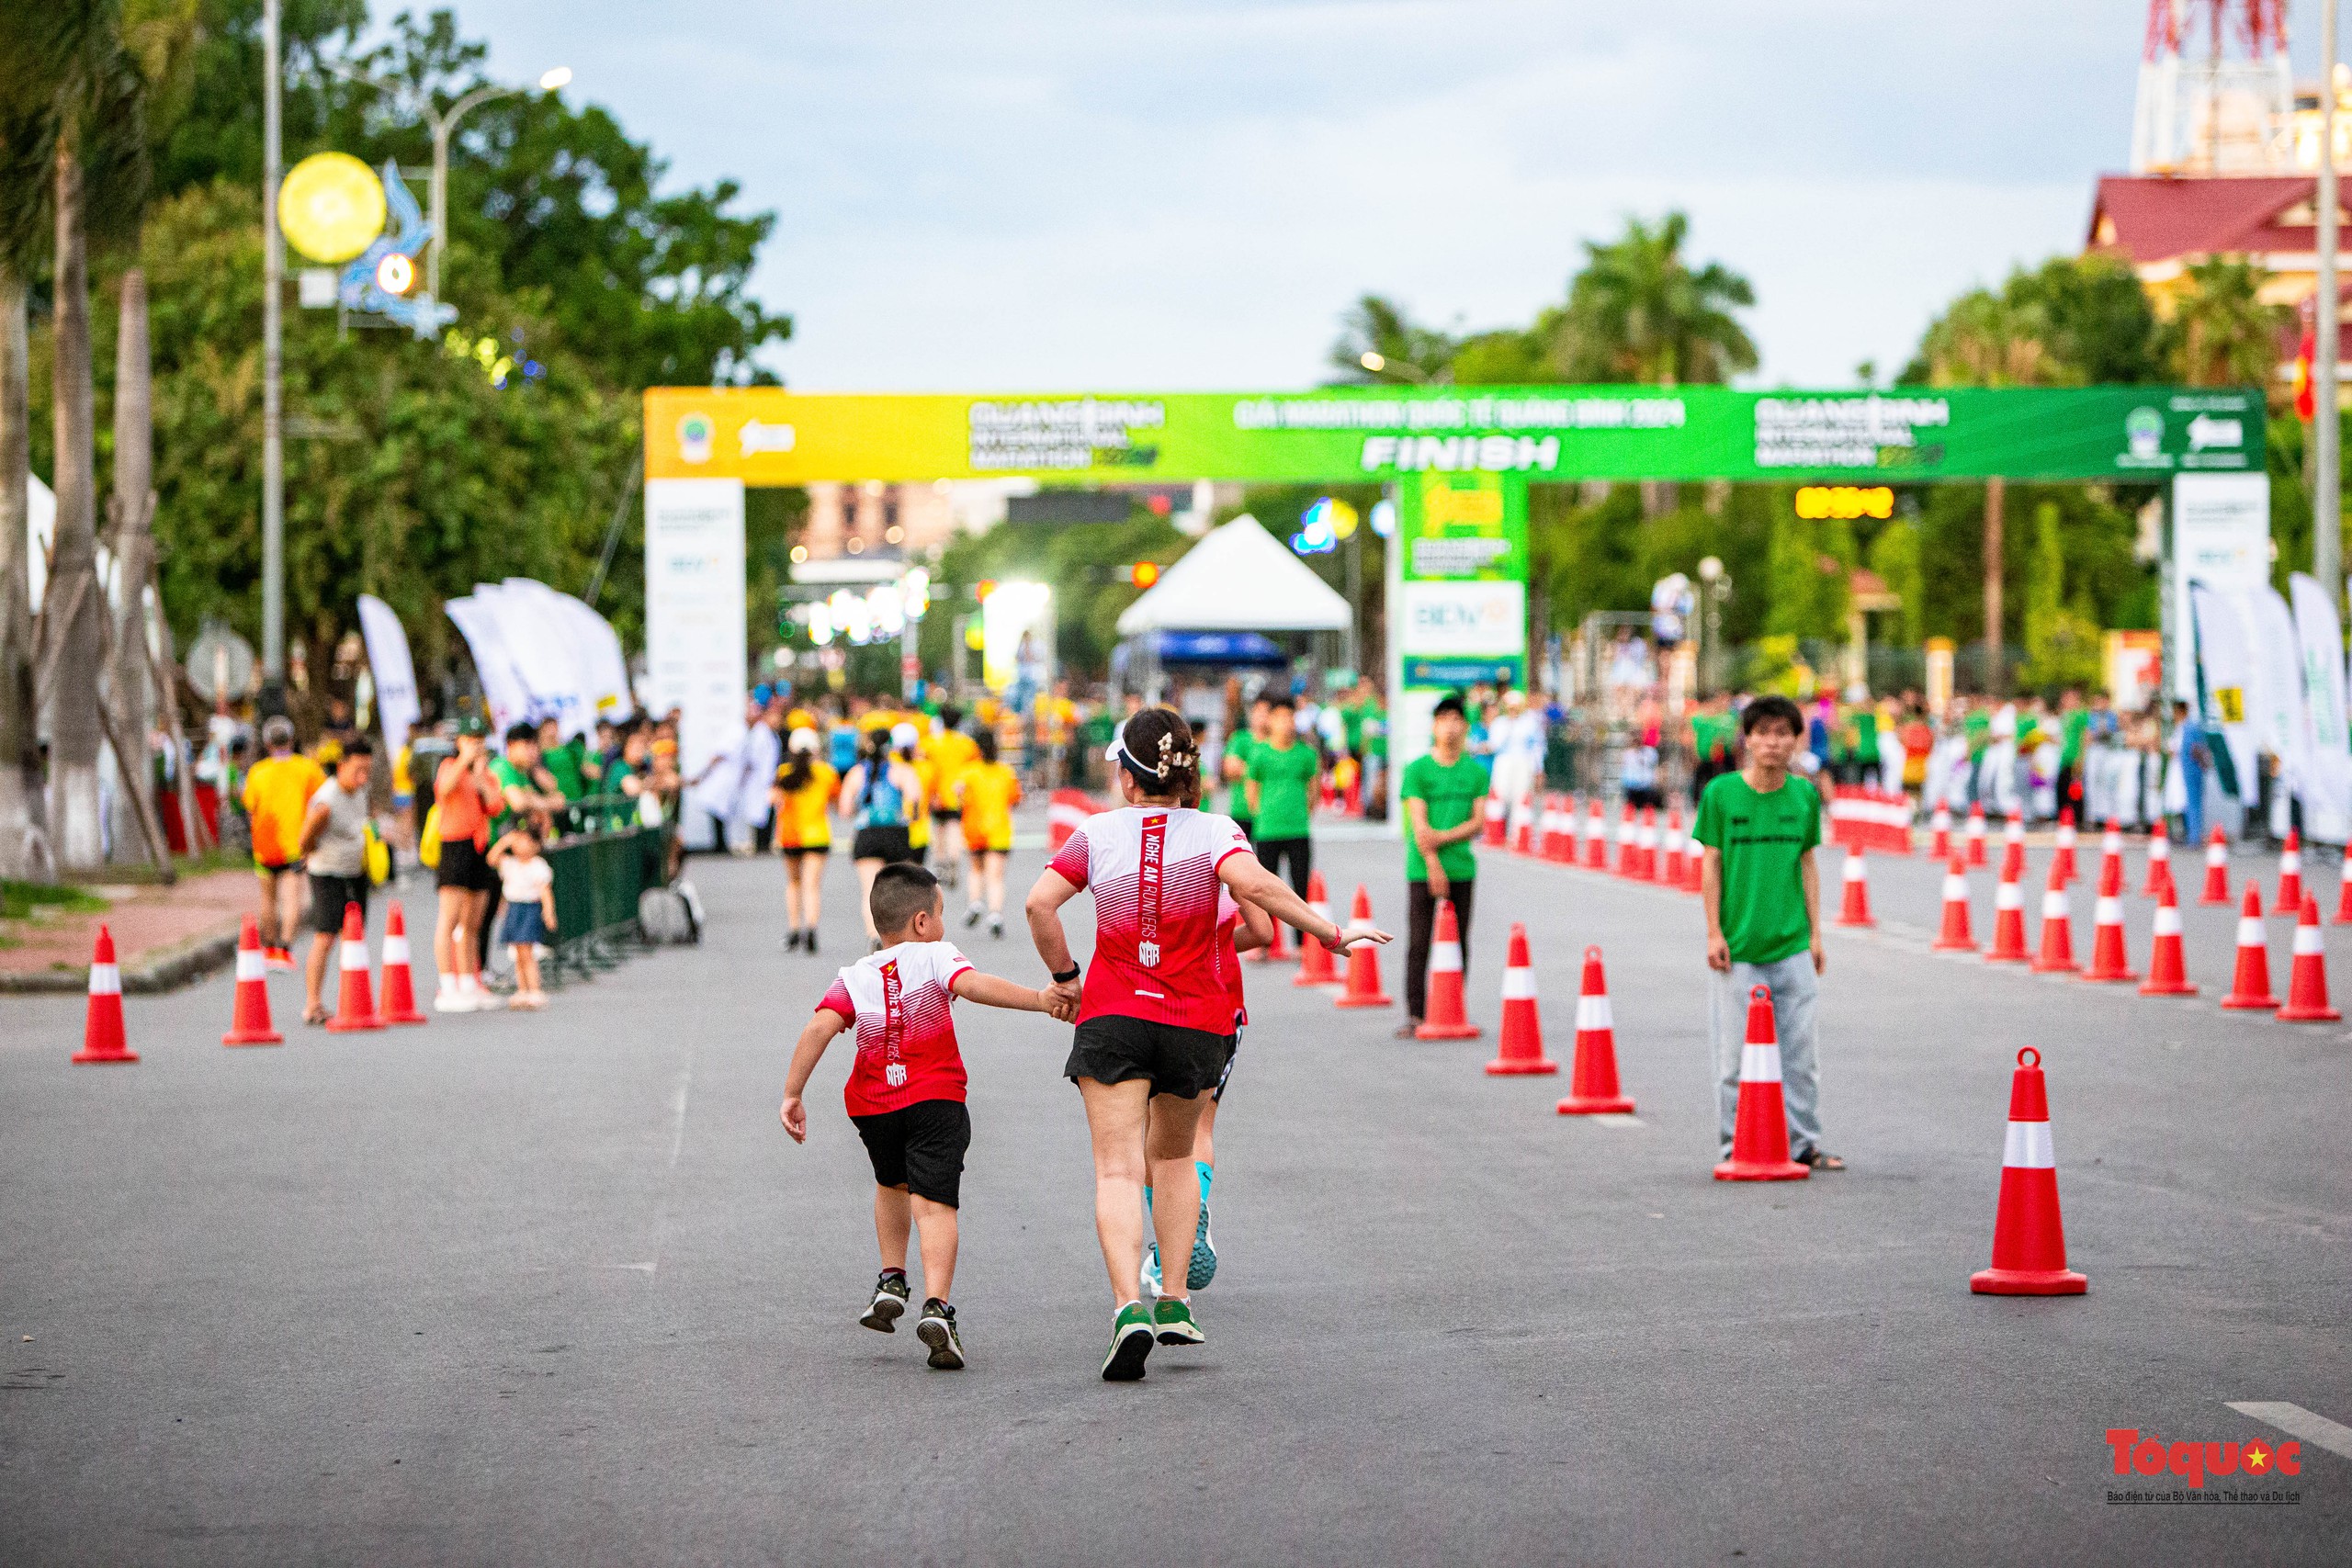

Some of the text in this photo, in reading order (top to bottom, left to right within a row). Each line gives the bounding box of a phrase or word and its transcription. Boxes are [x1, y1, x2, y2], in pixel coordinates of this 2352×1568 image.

[1360, 435, 1561, 472] FINISH
[1141, 833, 1160, 940] NGHE AN RUNNERS
